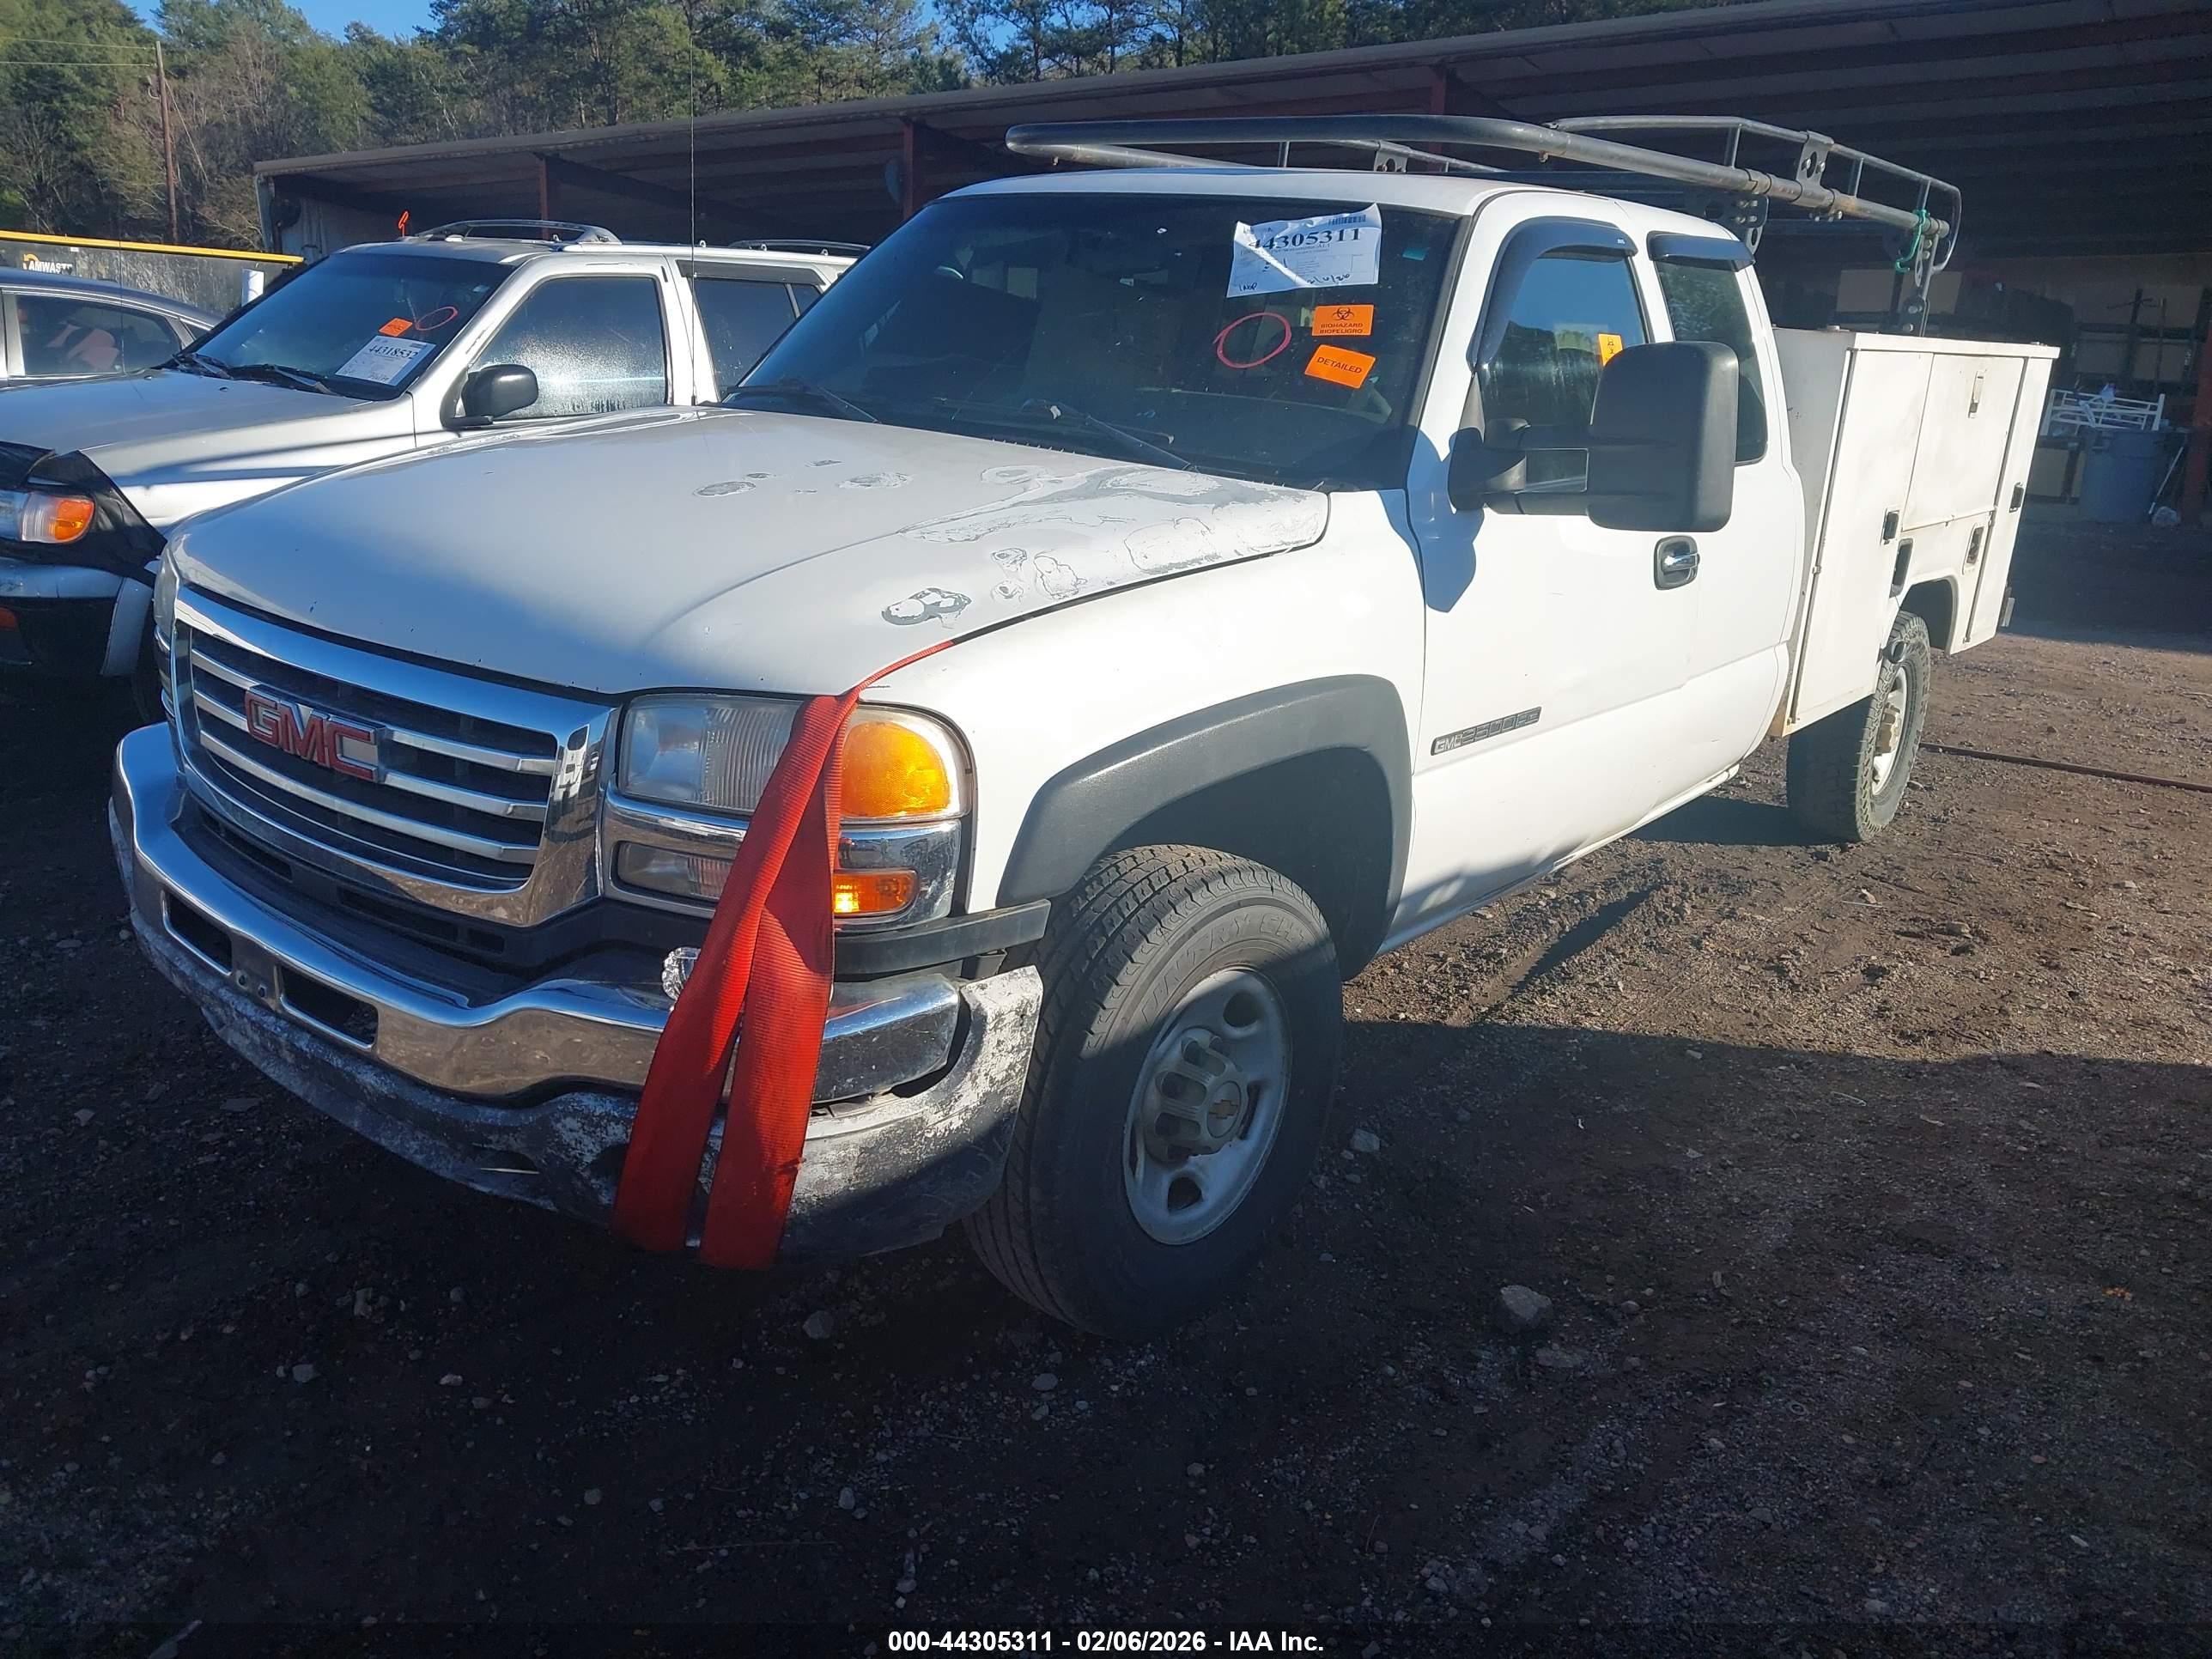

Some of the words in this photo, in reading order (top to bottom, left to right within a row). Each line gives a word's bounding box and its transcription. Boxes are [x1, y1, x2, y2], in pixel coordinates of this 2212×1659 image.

[1249, 228, 1361, 250] 44305311
[368, 345, 418, 360] 44318532
[1317, 356, 1363, 374] DETAILED
[245, 688, 379, 783] GMC
